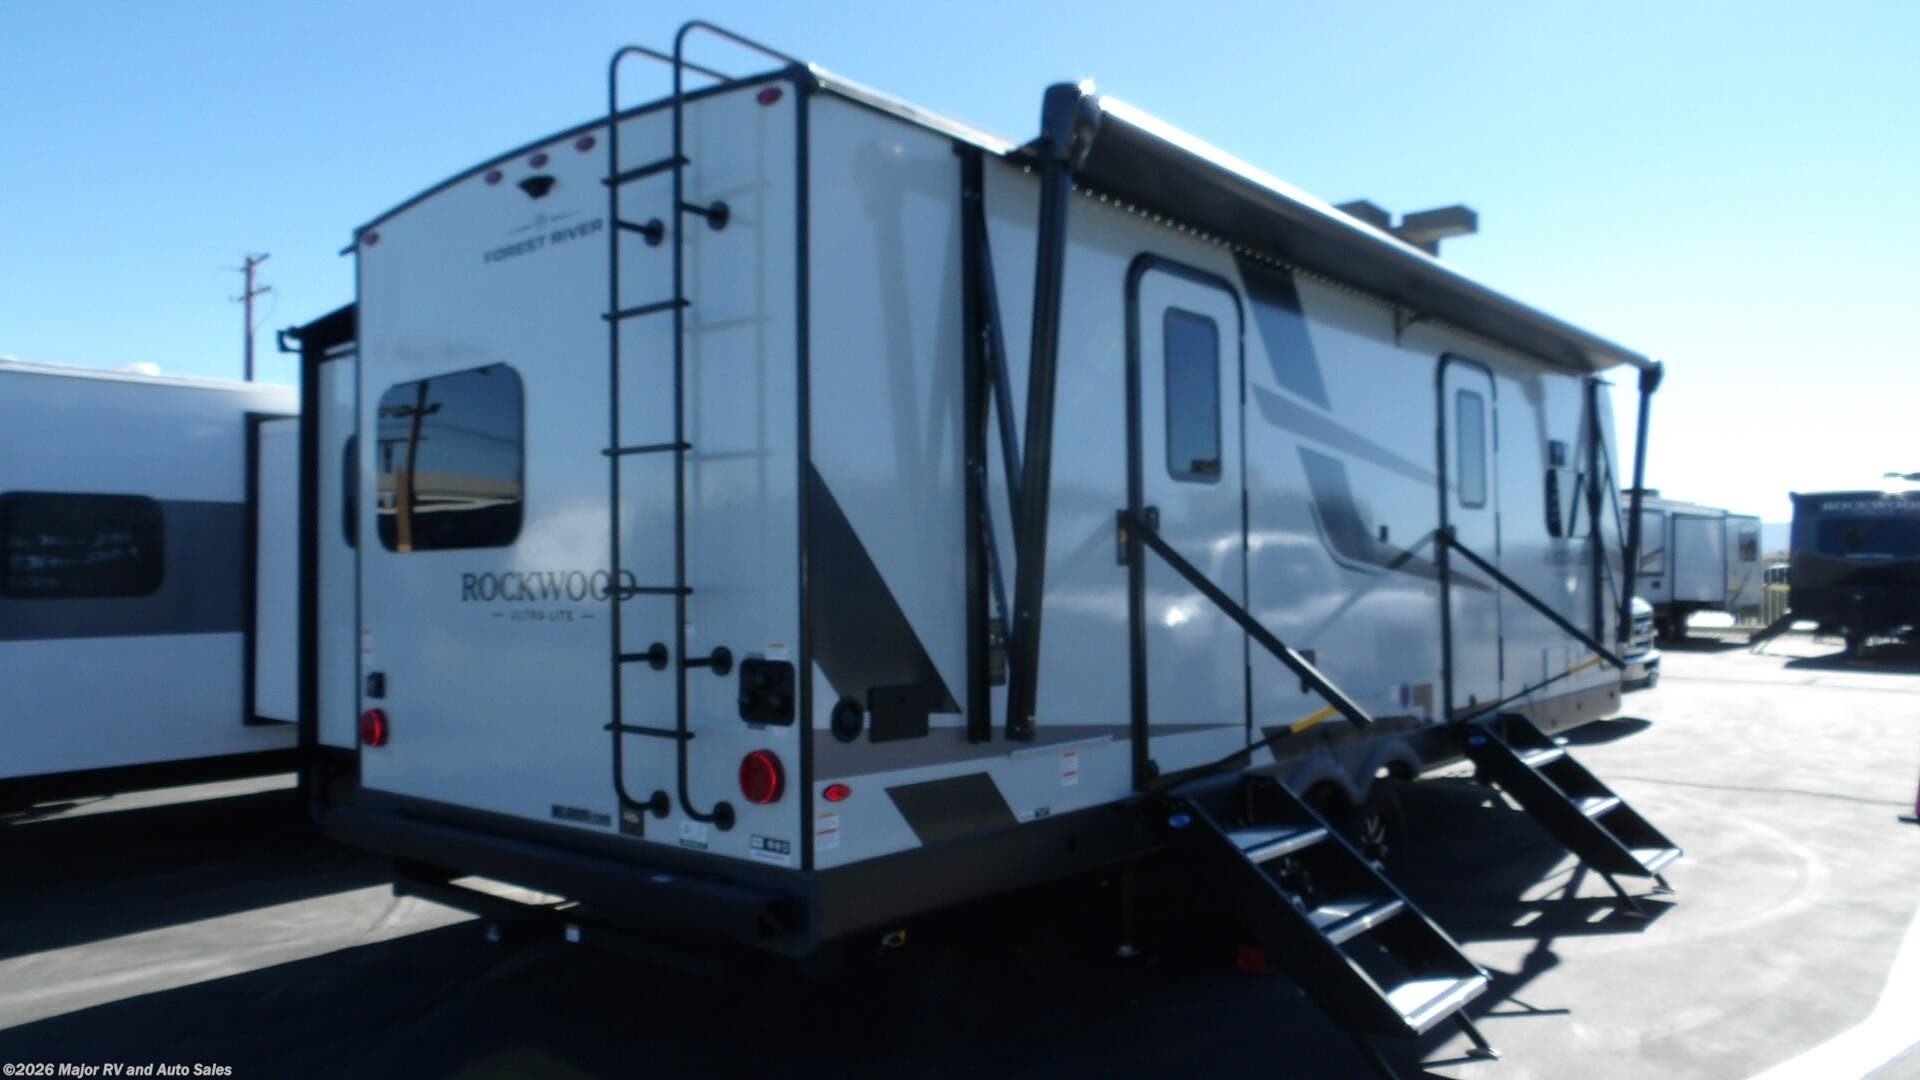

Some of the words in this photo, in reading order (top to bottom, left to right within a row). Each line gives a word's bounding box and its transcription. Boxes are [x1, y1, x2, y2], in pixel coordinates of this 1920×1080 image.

[484, 235, 548, 263] FOREST
[551, 217, 603, 245] RIVER
[461, 570, 637, 602] ROCKWOOD
